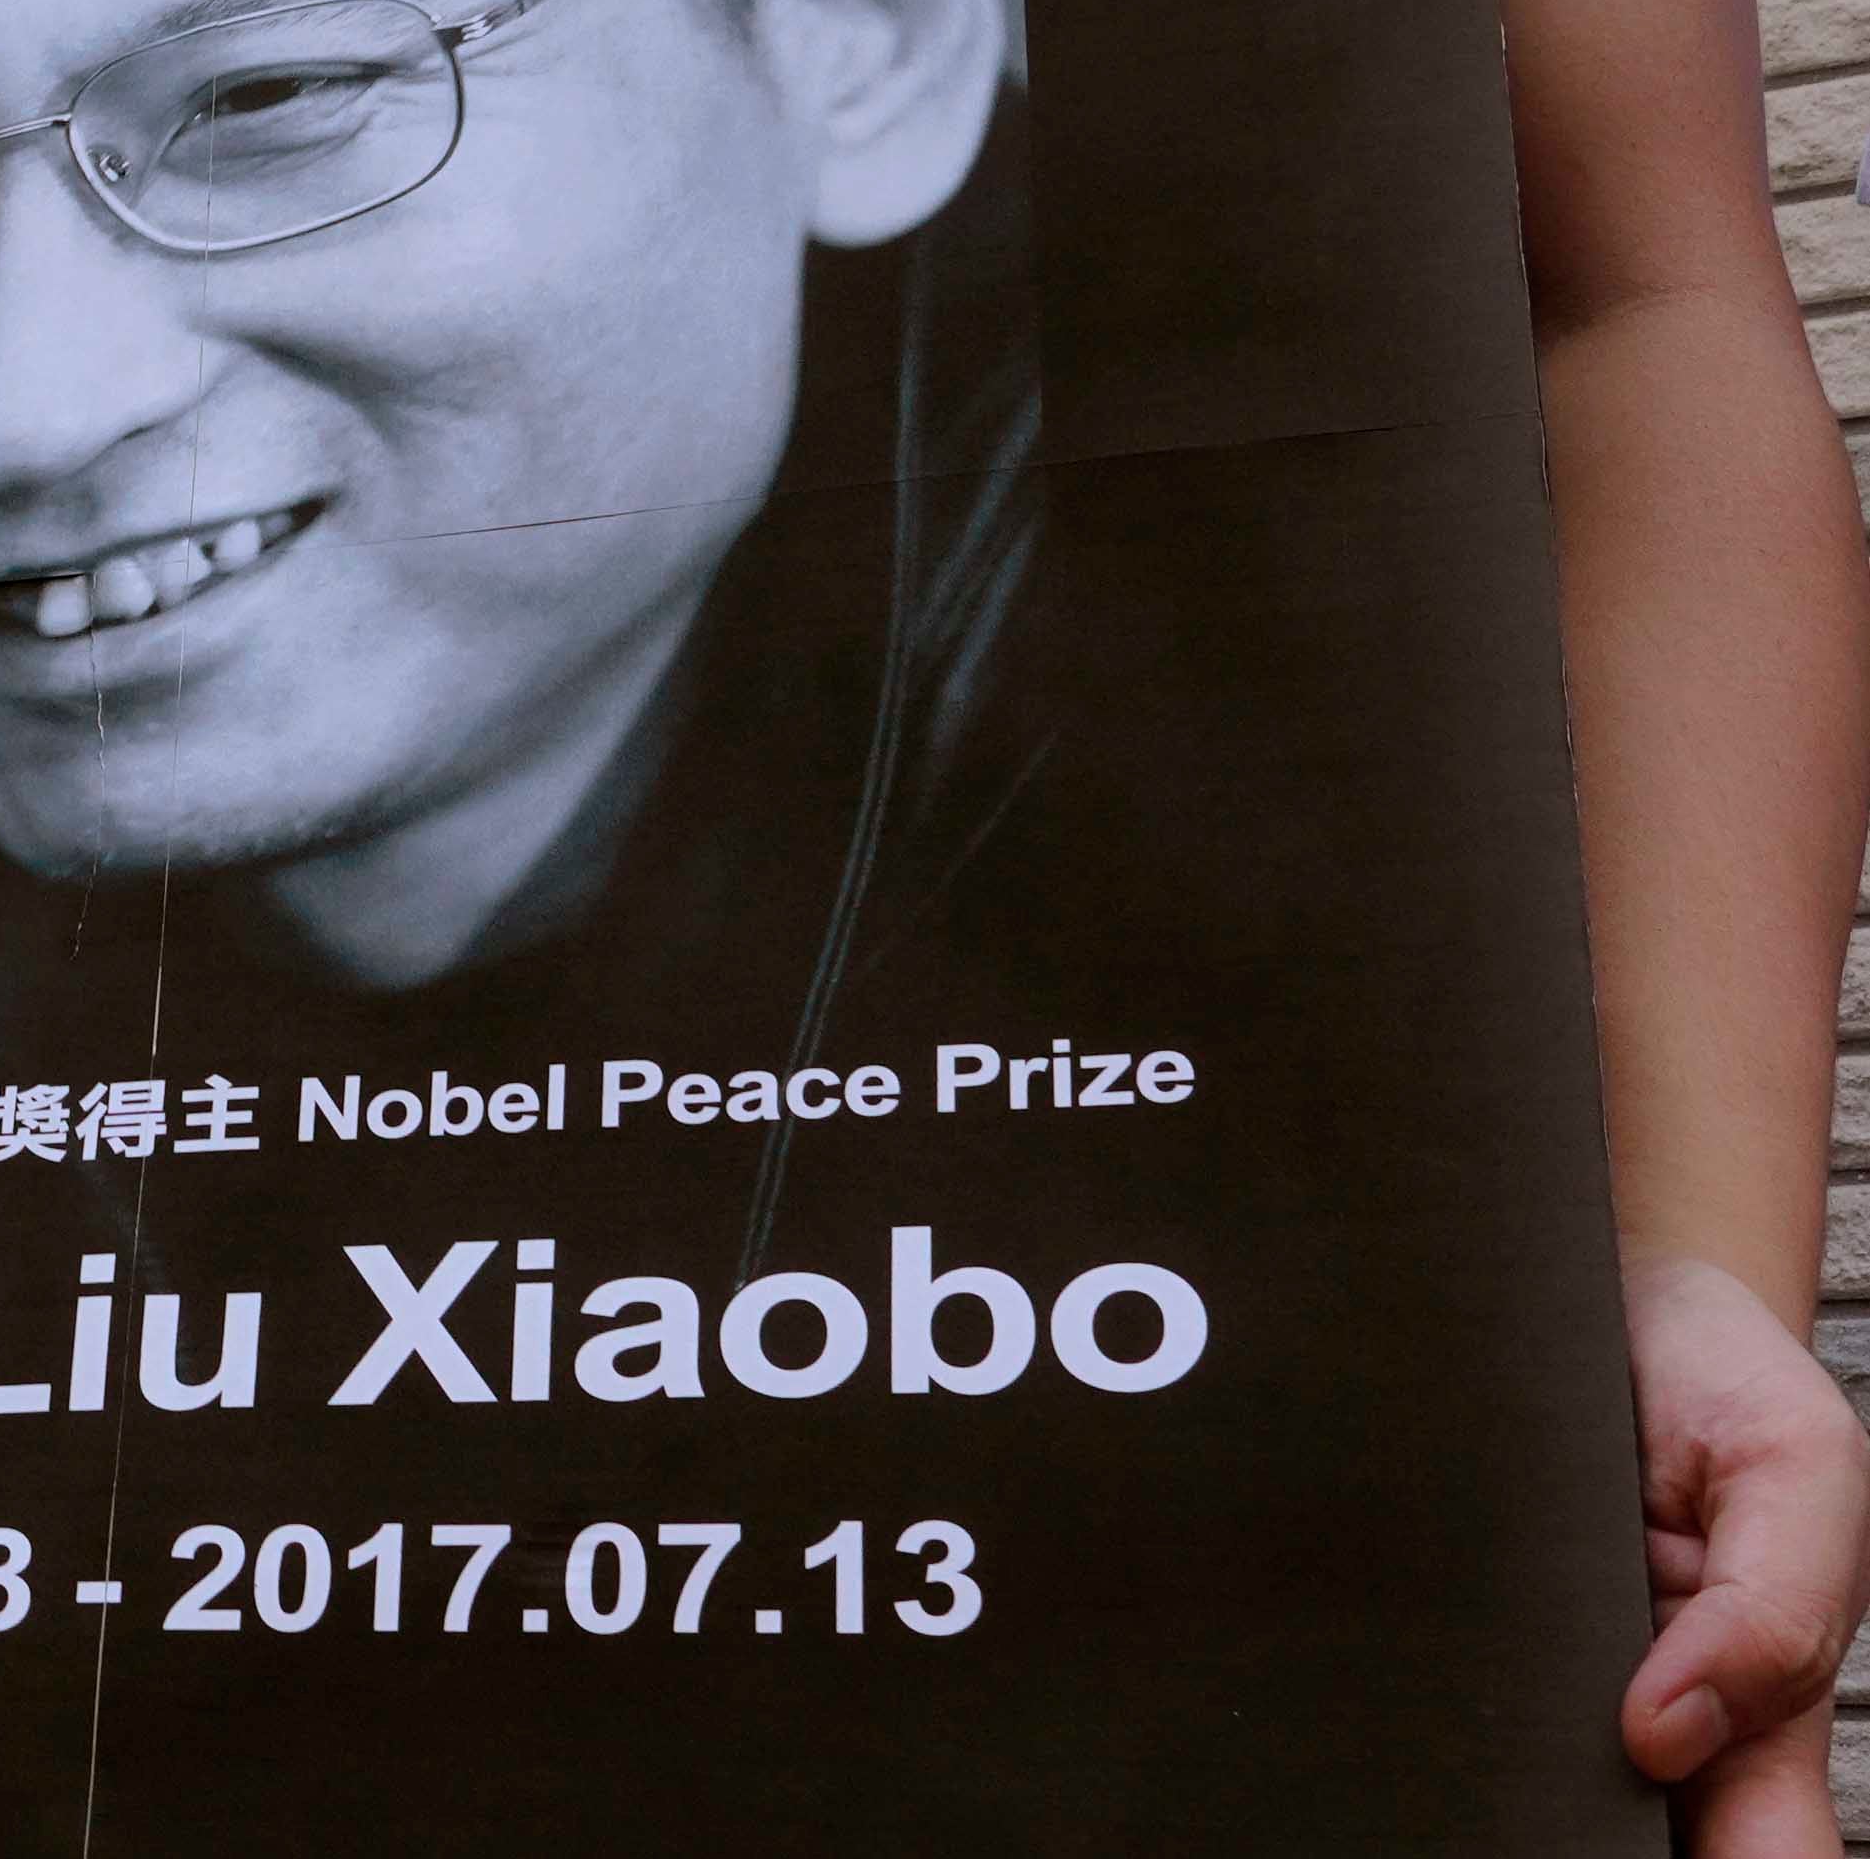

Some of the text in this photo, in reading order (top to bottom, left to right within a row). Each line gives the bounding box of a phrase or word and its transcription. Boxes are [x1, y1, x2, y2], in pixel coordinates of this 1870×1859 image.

[298, 1062, 566, 1144] Nobel
[600, 1058, 902, 1130] Peace
[934, 1038, 1196, 1114] Prize
[327, 1224, 1210, 1408] Xiaobo
[74, 1578, 123, 1605] -
[164, 1517, 985, 1638] 2017.07.13
